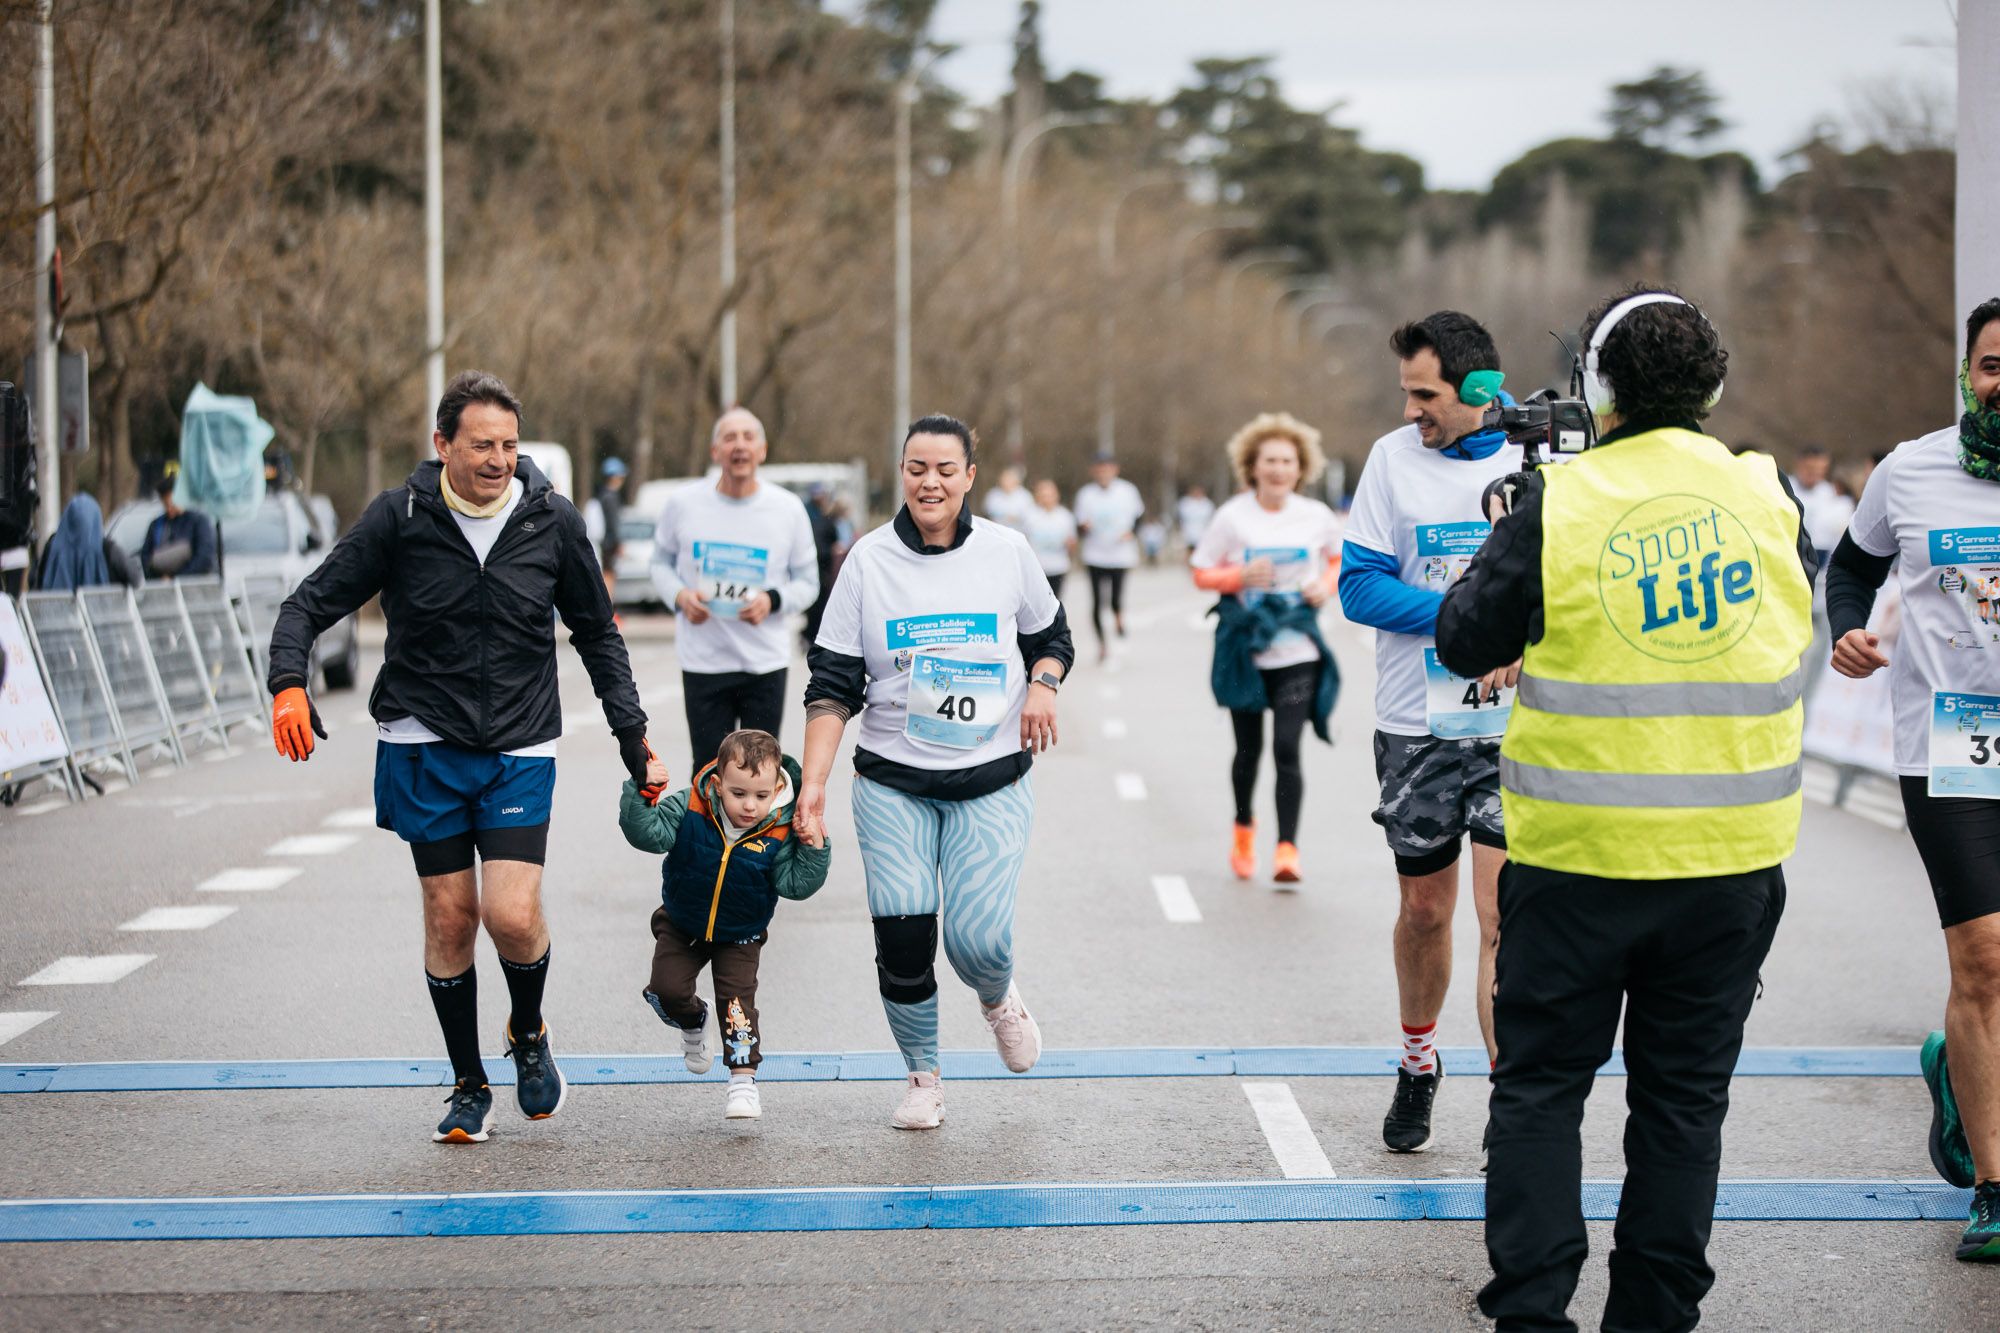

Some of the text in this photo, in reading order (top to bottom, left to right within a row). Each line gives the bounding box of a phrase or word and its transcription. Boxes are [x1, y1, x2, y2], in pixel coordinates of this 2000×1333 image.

[1440, 530, 1472, 539] Carrera
[1956, 535, 1995, 544] Carrera
[1609, 508, 1726, 580] Sport
[1637, 551, 1756, 633] Life
[907, 622, 938, 631] Carrera
[940, 619, 976, 628] Solidaria
[967, 634, 994, 644] 2026
[934, 663, 963, 674] Carrera
[964, 667, 993, 676] Solidaria
[1461, 682, 1501, 709] 44
[936, 695, 976, 722] 40
[1958, 700, 1995, 710] Carrera
